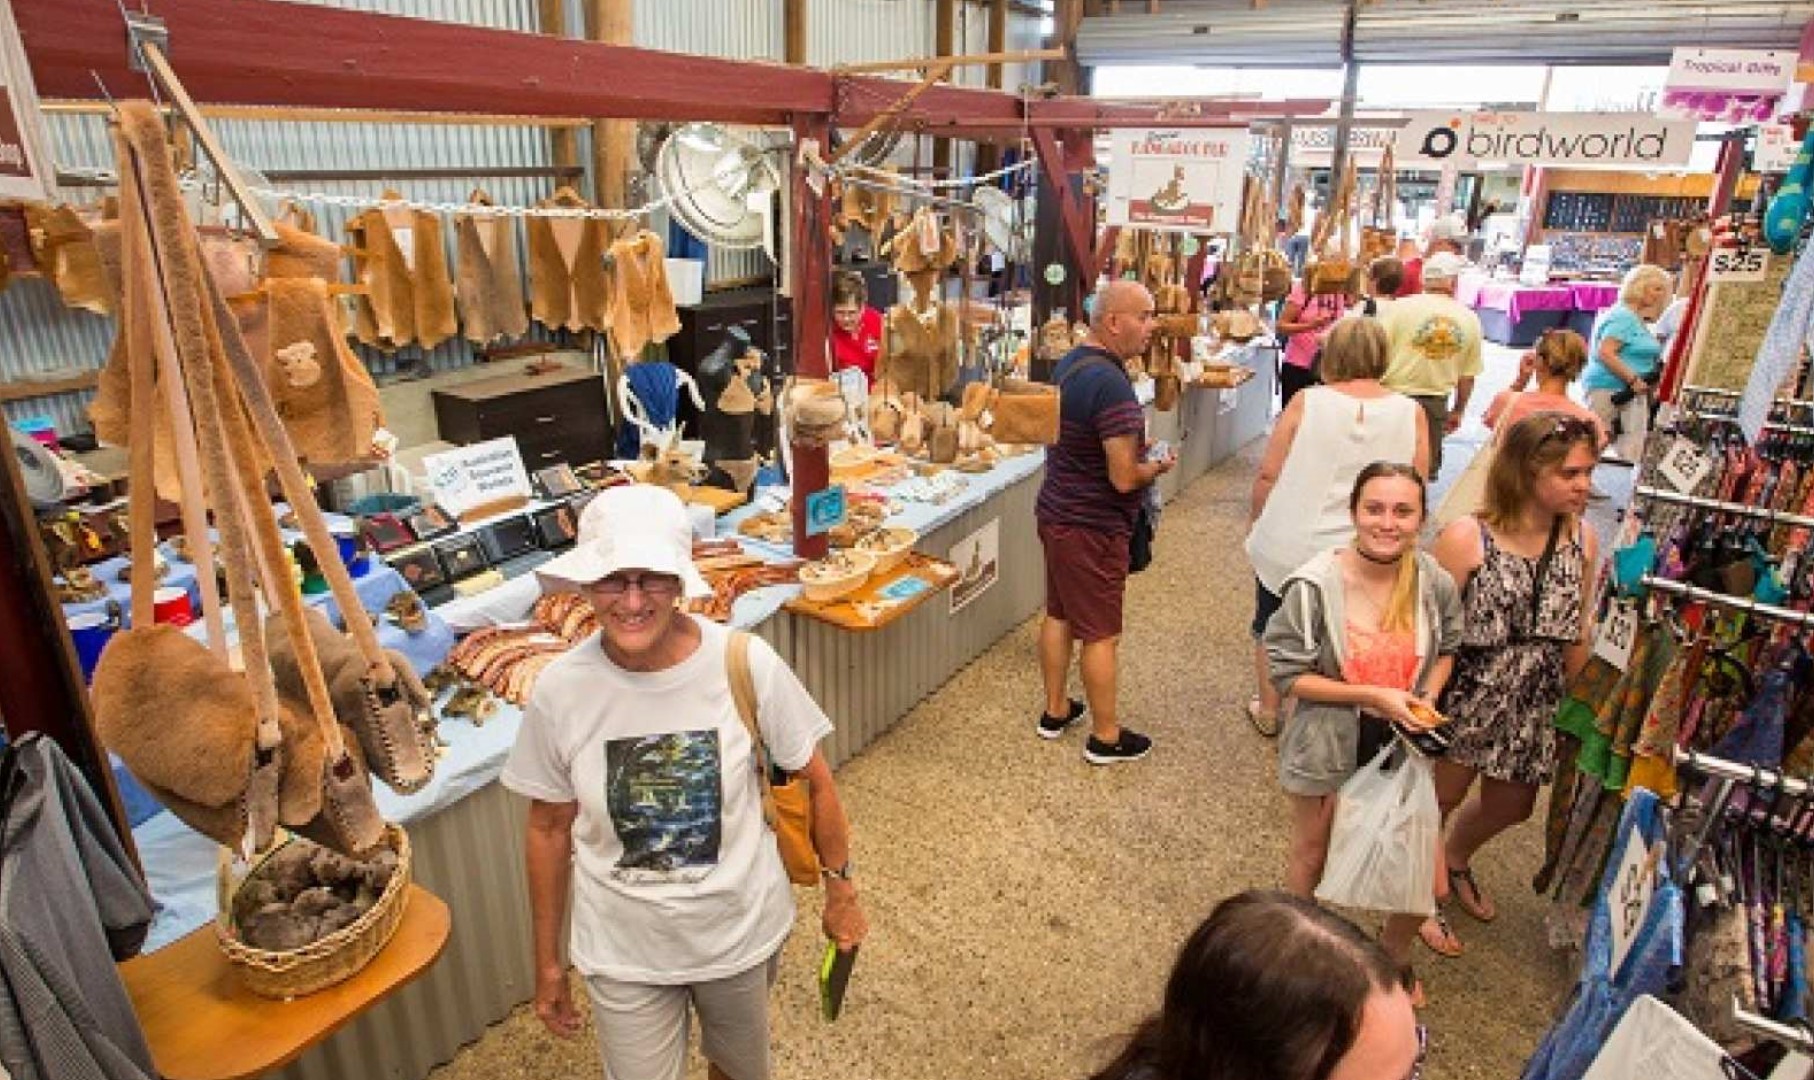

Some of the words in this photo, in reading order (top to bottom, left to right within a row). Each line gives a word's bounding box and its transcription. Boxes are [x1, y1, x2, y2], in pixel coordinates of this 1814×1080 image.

[1684, 58, 1742, 74] Tropical
[1467, 126, 1668, 159] birdworld
[1714, 254, 1762, 275] $25
